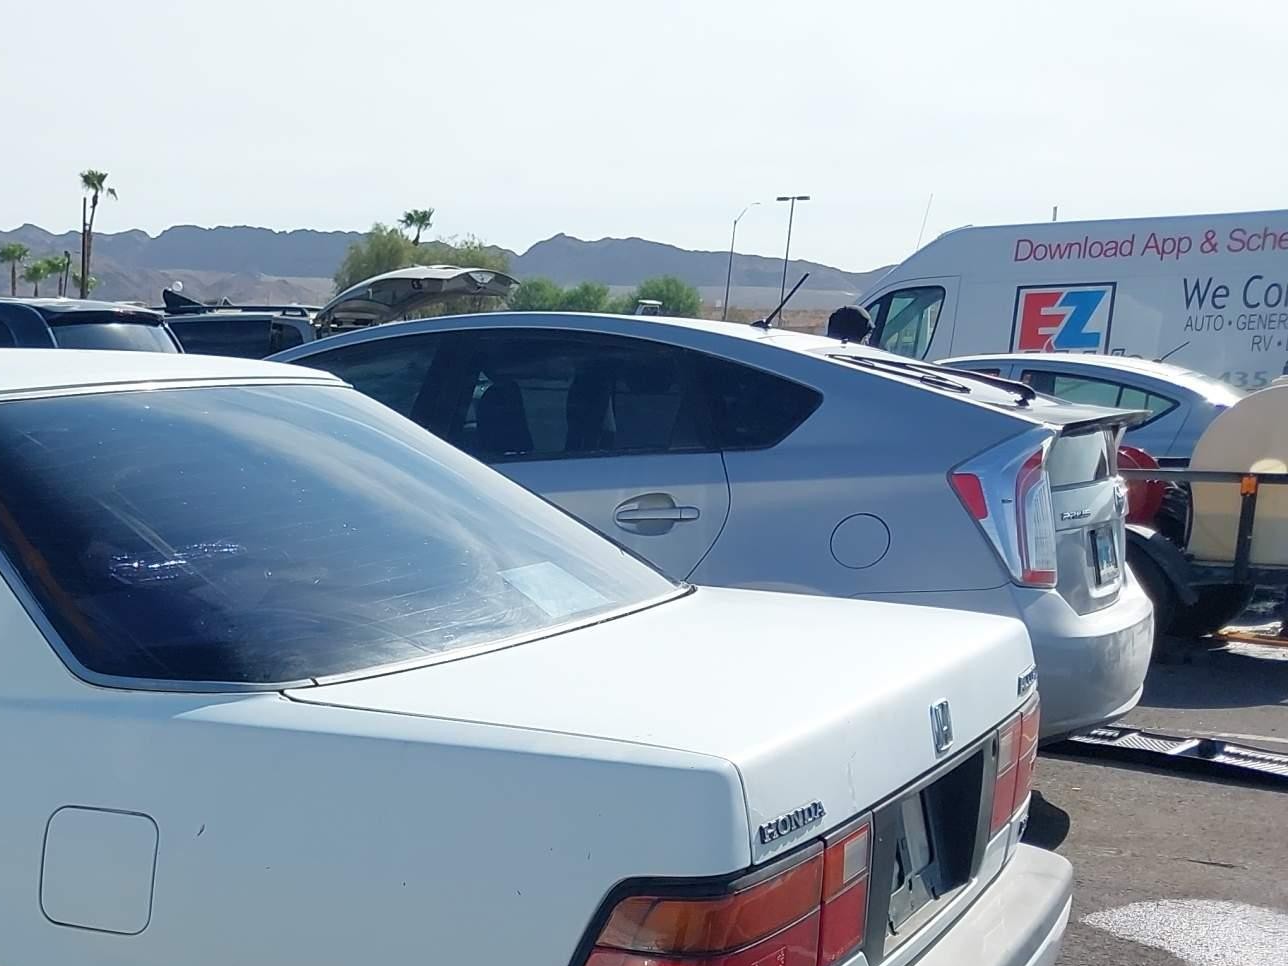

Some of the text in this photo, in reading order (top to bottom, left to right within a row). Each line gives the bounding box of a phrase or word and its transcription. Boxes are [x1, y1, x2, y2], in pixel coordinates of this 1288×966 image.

[1014, 234, 1136, 262] Download
[1141, 232, 1193, 262] App
[1200, 228, 1220, 254] &
[1183, 275, 1288, 310] We Co
[1018, 290, 1108, 351] EZ
[1184, 314, 1225, 332] AUTO
[1251, 335, 1274, 352] RV
[759, 800, 827, 844] HONDA
